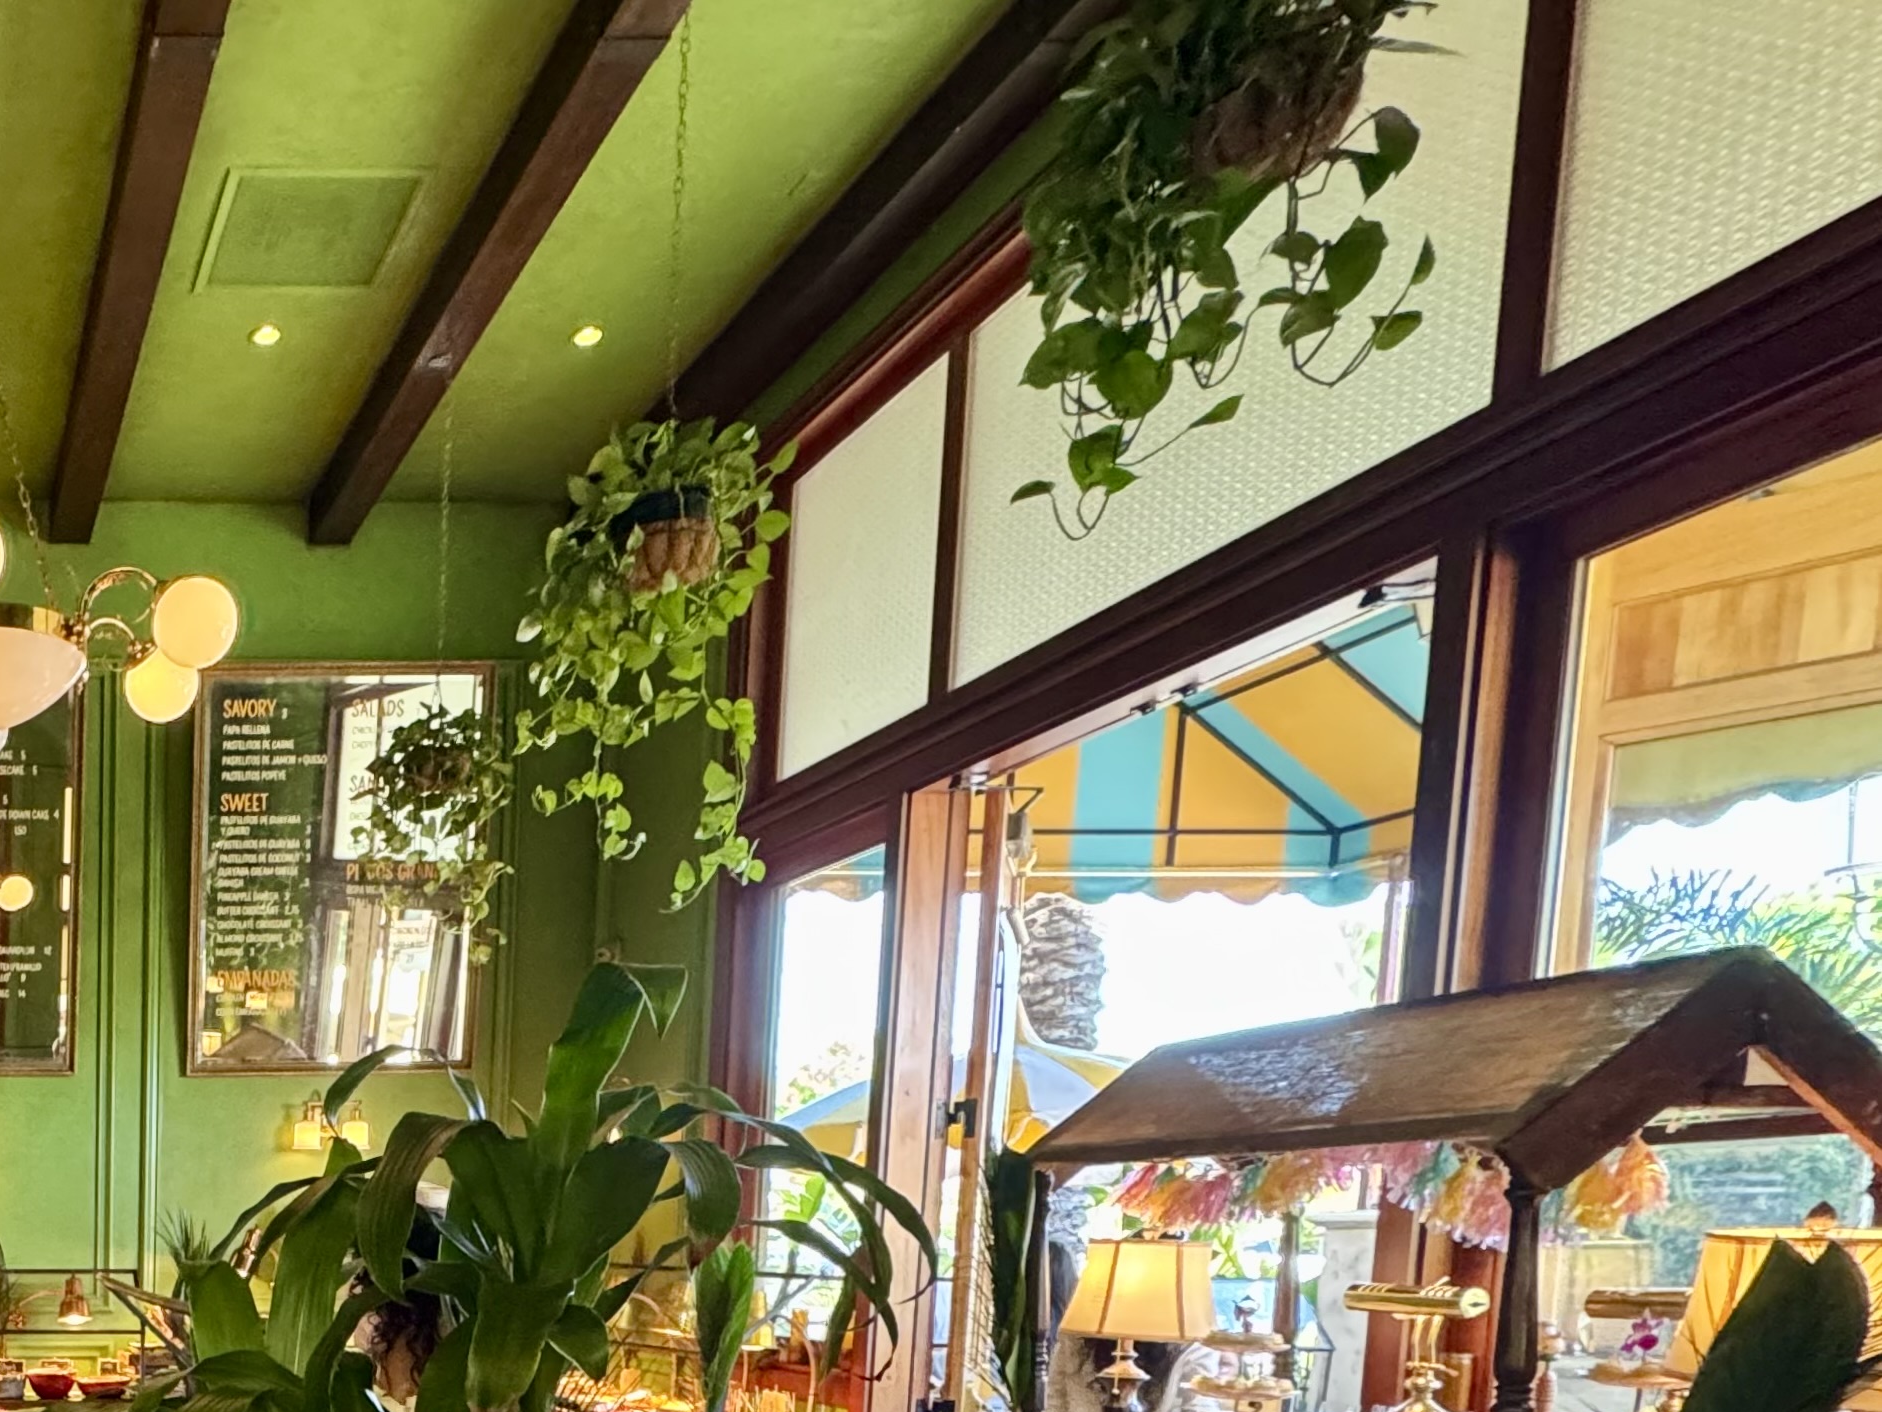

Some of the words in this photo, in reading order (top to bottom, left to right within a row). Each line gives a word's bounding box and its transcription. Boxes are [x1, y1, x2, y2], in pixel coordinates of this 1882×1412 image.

[223, 699, 277, 718] SAVORY
[223, 724, 240, 735] PAPA
[241, 724, 270, 735] RELLENA
[223, 740, 261, 751] PASTELITOS
[262, 740, 270, 751] DE
[222, 756, 260, 766] PASTELITOS
[262, 755, 270, 765] DE
[221, 771, 260, 782] PASTELITOS
[220, 793, 269, 812] SWEET
[32, 809, 49, 820] CAKE
[53, 809, 60, 819] 4
[220, 816, 258, 825] PASTELITOS
[219, 854, 258, 864] PASTELITOS
